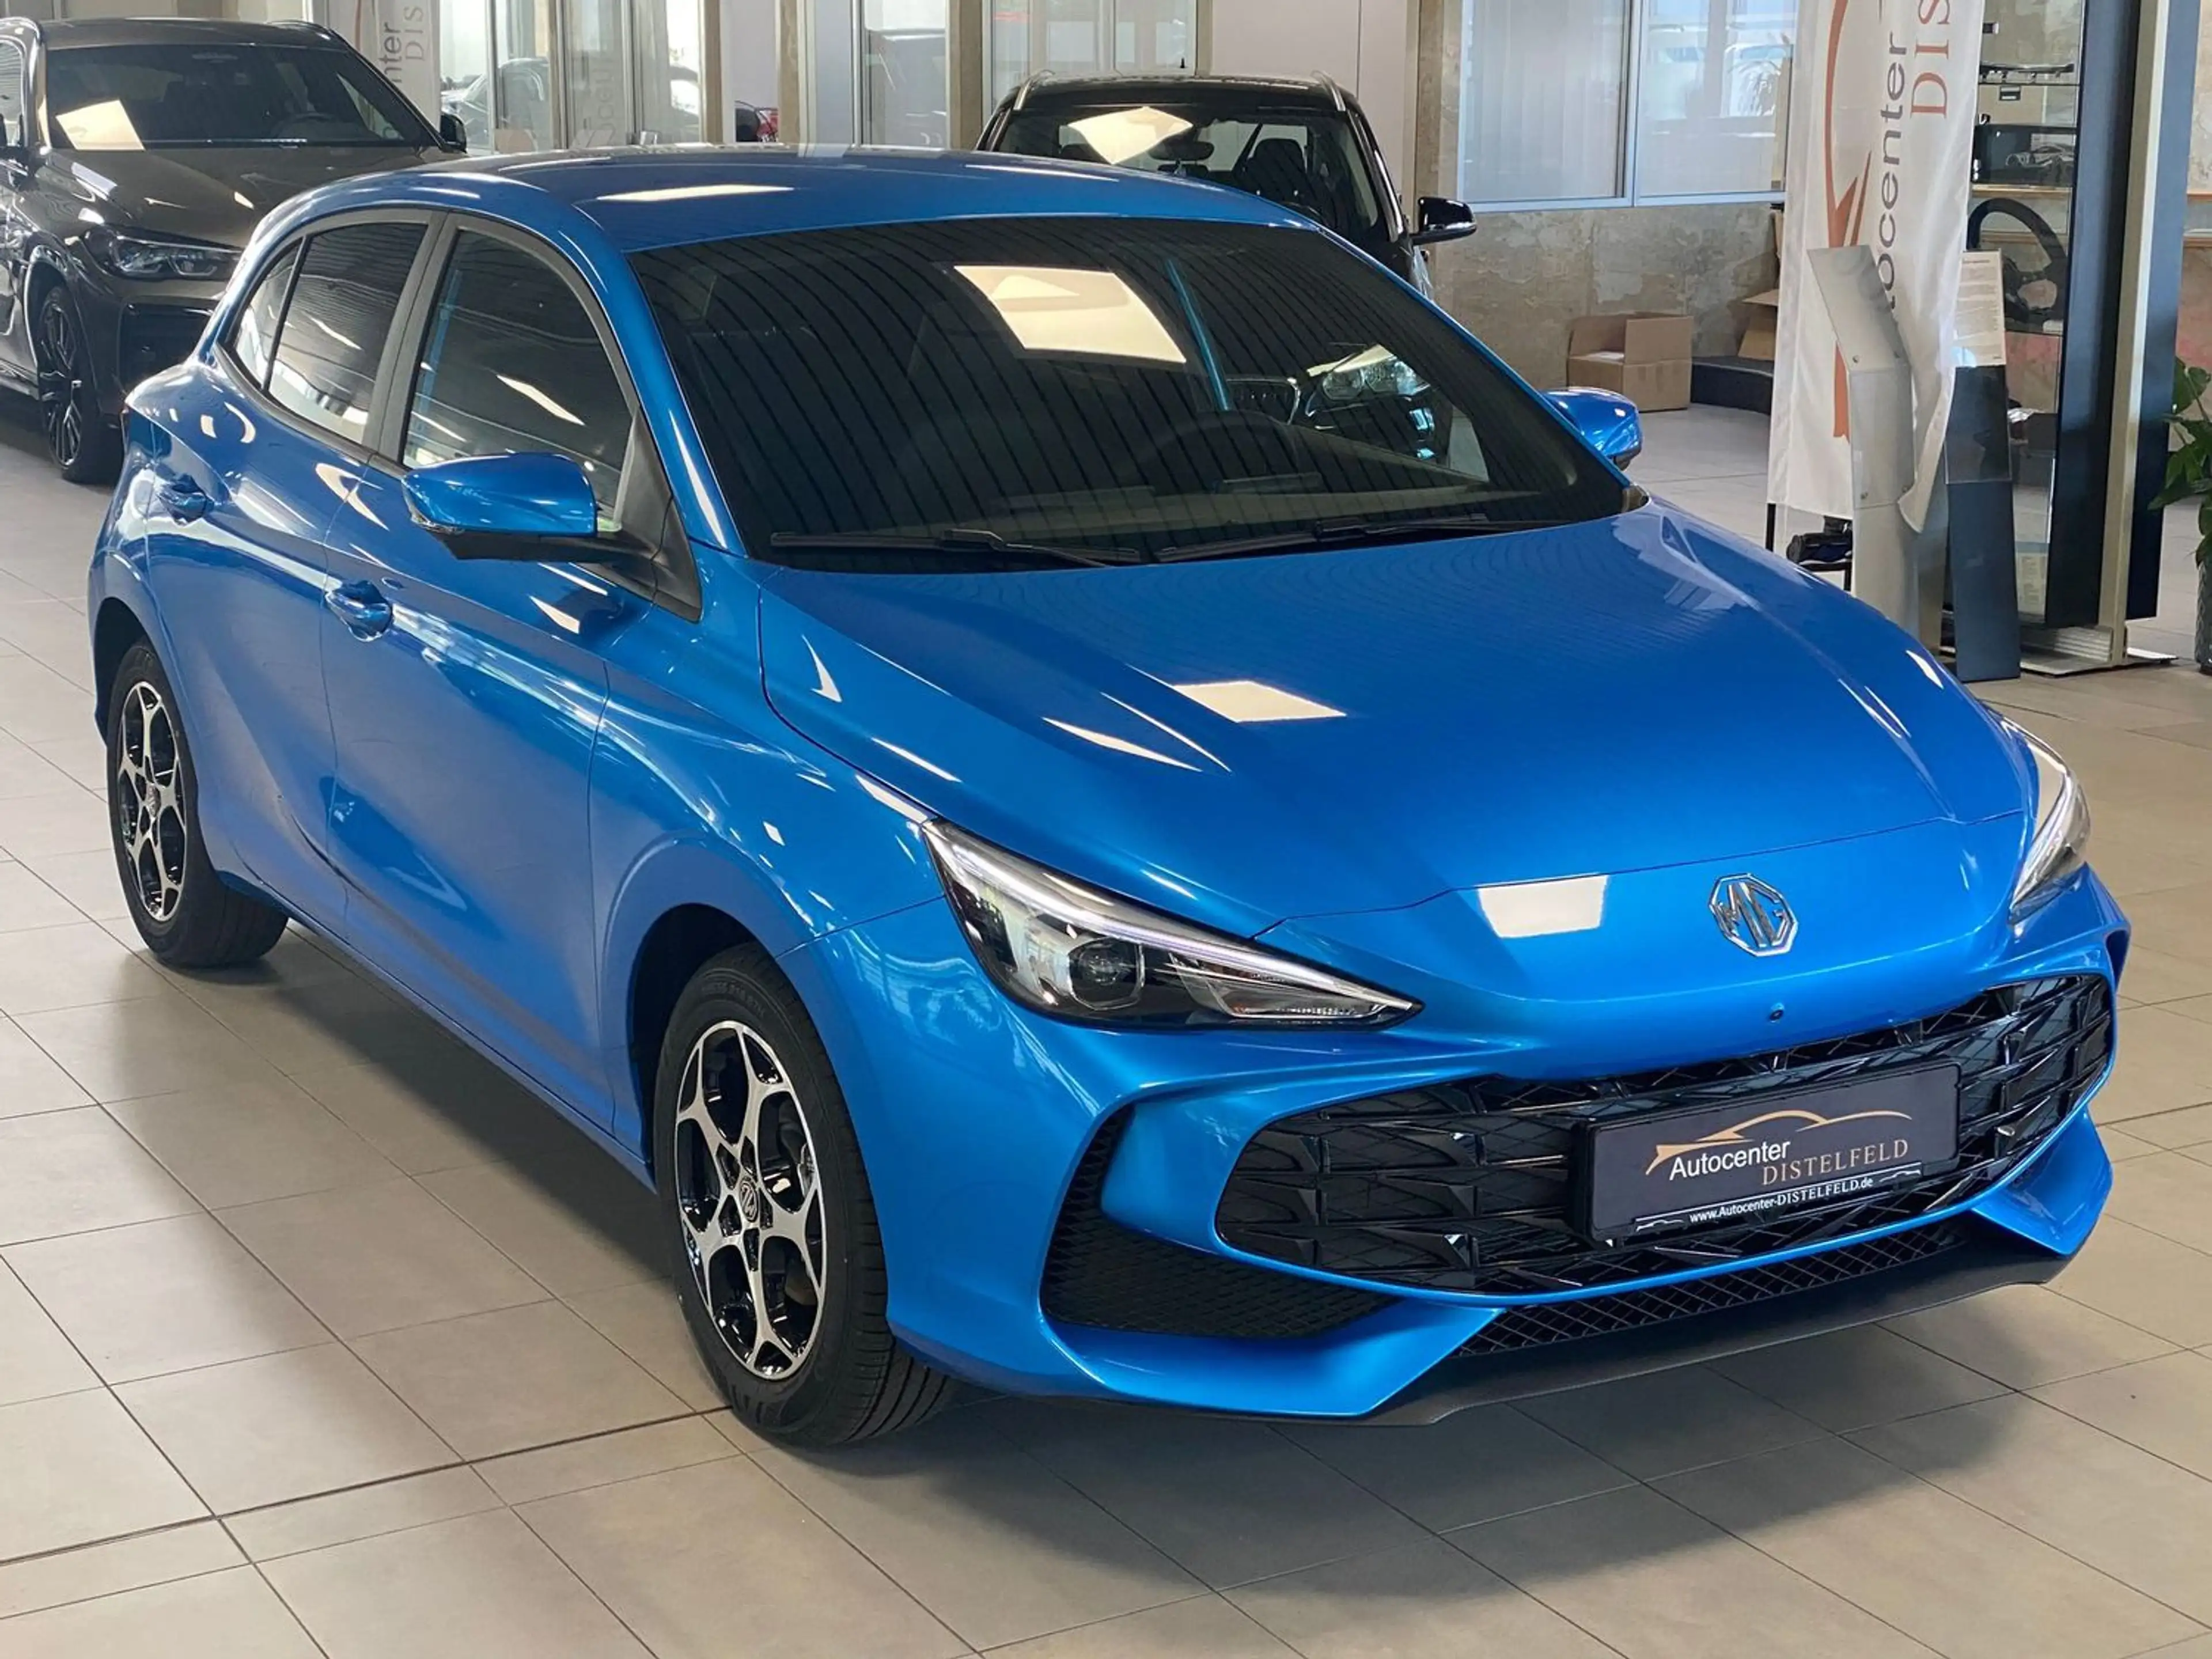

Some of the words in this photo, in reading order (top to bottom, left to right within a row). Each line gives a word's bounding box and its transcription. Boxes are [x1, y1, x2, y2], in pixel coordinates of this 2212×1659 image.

[1877, 31, 1907, 309] ocenter
[1715, 878, 1790, 948] MG
[1669, 1141, 1791, 1180] Autocenter
[1763, 1139, 1908, 1185] DISTELFELD
[1690, 1178, 1873, 1222] www.Autocenter-DISTELFELD.de
